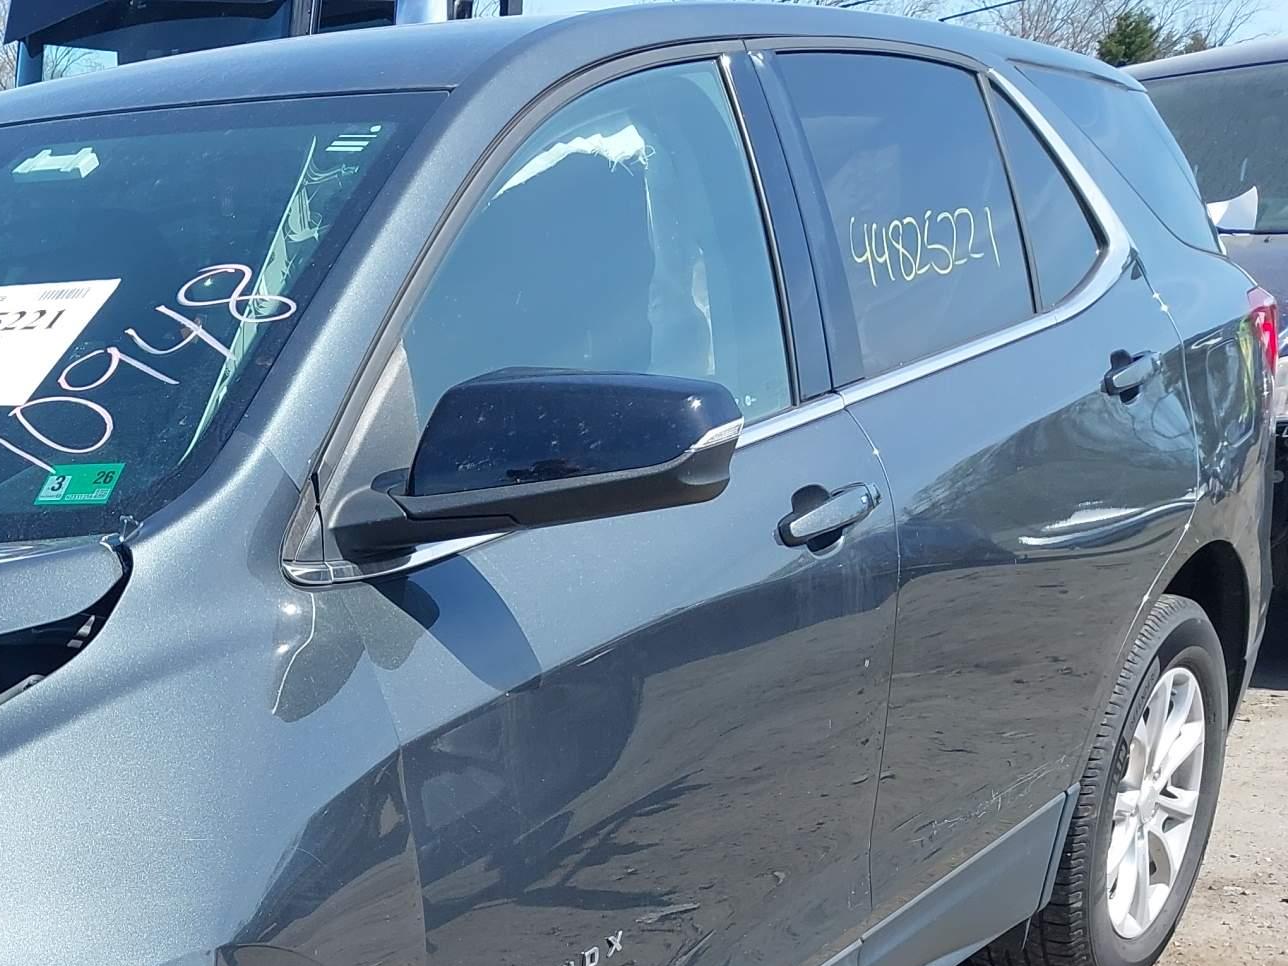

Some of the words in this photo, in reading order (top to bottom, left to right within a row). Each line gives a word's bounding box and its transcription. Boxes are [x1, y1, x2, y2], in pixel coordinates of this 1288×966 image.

[850, 206, 1001, 288] 44825221
[50, 475, 66, 492] 3
[93, 470, 116, 485] 26
